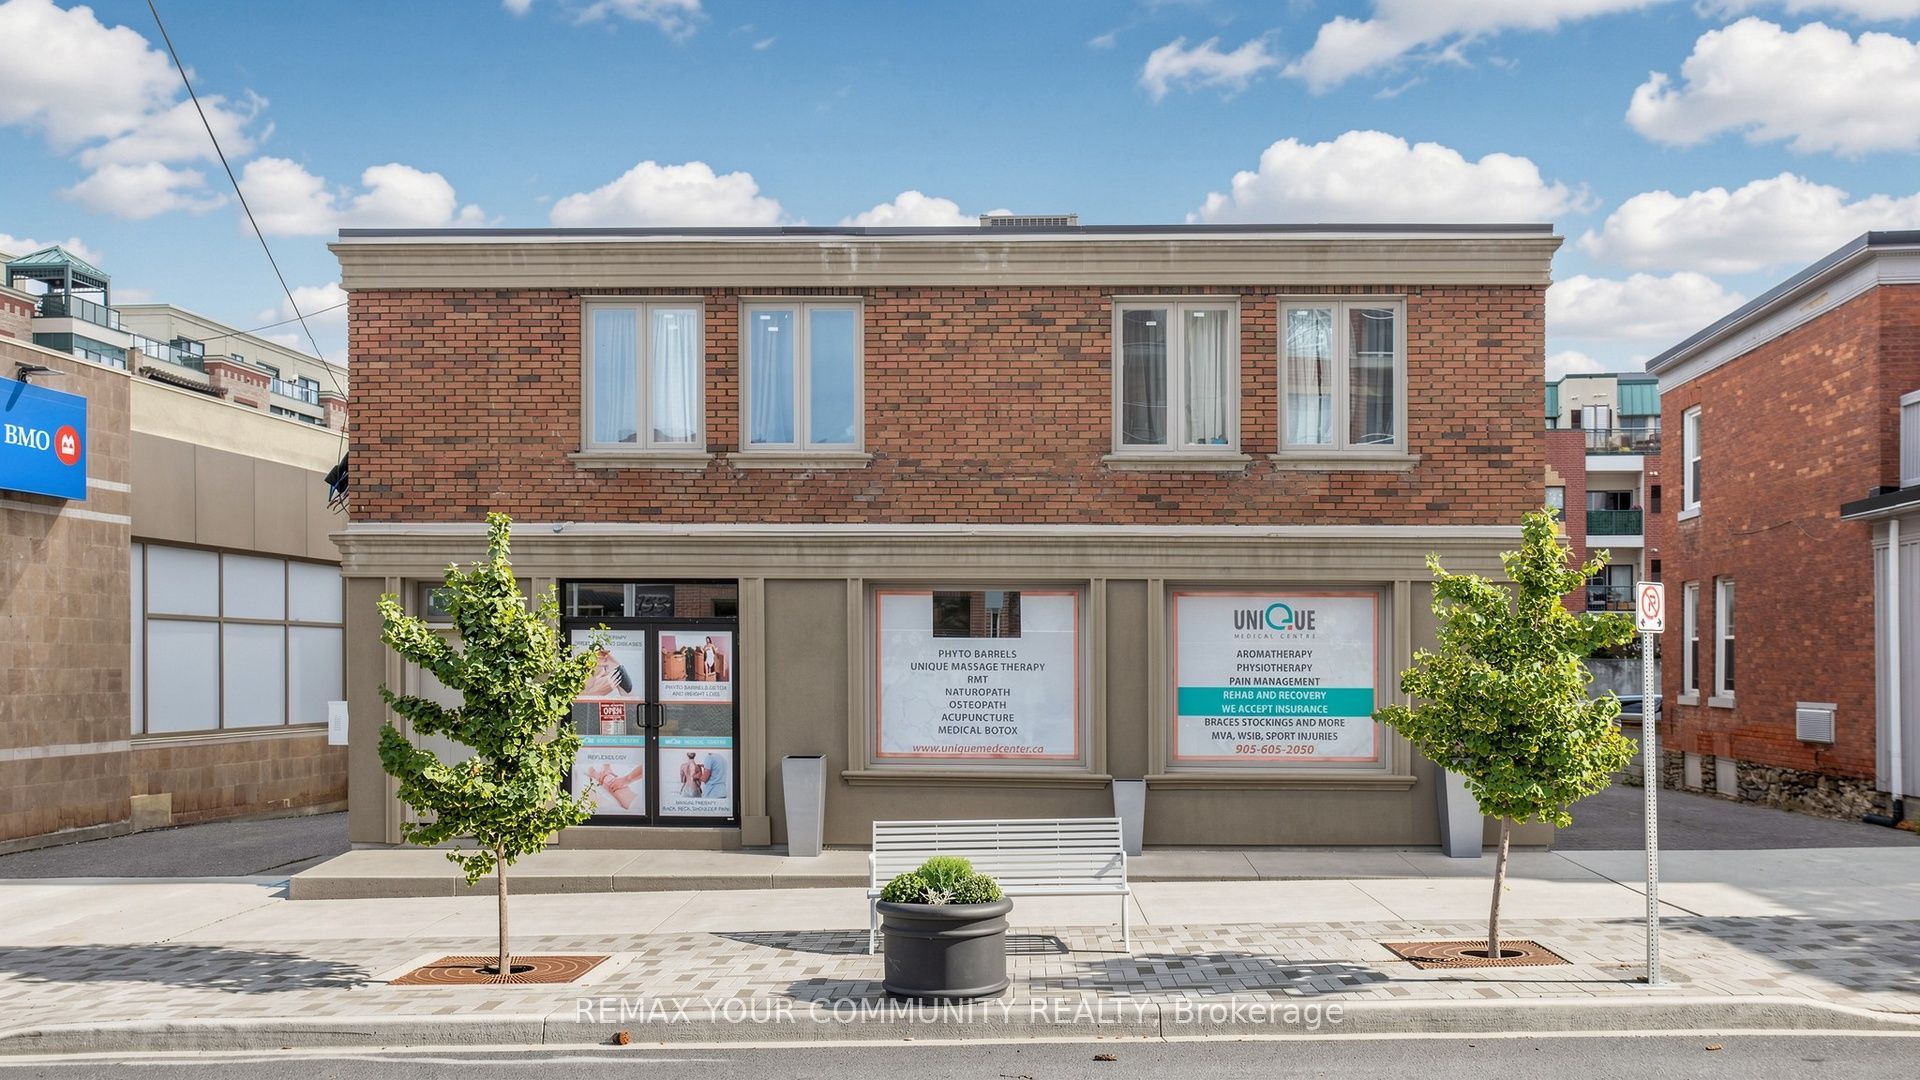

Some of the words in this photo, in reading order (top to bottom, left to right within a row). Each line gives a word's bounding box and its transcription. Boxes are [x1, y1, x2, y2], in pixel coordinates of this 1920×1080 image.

[4, 424, 50, 451] BMO
[1233, 602, 1316, 631] UNIQUE
[938, 649, 972, 659] PHYTO
[974, 649, 1017, 659] BARRELS
[1236, 649, 1313, 659] AROMATHERAPY
[910, 662, 949, 671] UNIQUE
[951, 662, 999, 671] MASSAGE
[1001, 662, 1046, 671] THERAPY
[1236, 663, 1313, 673] PHYSIOTHERAPY
[967, 675, 989, 684] RMT
[1229, 677, 1252, 686] PAIN
[1253, 677, 1320, 686] MANAGEMENT
[945, 688, 1011, 697] NATUROPATH
[1223, 690, 1254, 700] REHAB
[1256, 690, 1277, 700] AND
[1279, 690, 1327, 700] RECOVERY
[949, 700, 1007, 710] OSTEOPATH
[1222, 704, 1237, 714] WE
[1238, 704, 1274, 714] ACCEPT
[1275, 704, 1328, 714] INSURANCE
[603, 707, 622, 715] OPEN
[941, 713, 1015, 722] ACUPUNCTURE
[1204, 717, 1240, 727] BRACES
[1242, 717, 1294, 727] STOCKINGS
[1296, 717, 1317, 727] AND
[1318, 717, 1345, 727] MORE
[938, 725, 982, 735] MEDICAL
[984, 725, 1018, 735] BOTOX
[1211, 731, 1235, 742] MVA,
[1237, 731, 1264, 742] WSIB,
[1266, 731, 1296, 742] SPORT
[1297, 731, 1338, 742] INJURIES
[912, 743, 1044, 755] www.uniquemedcenter.ca
[1236, 744, 1314, 755] 905-605-2050
